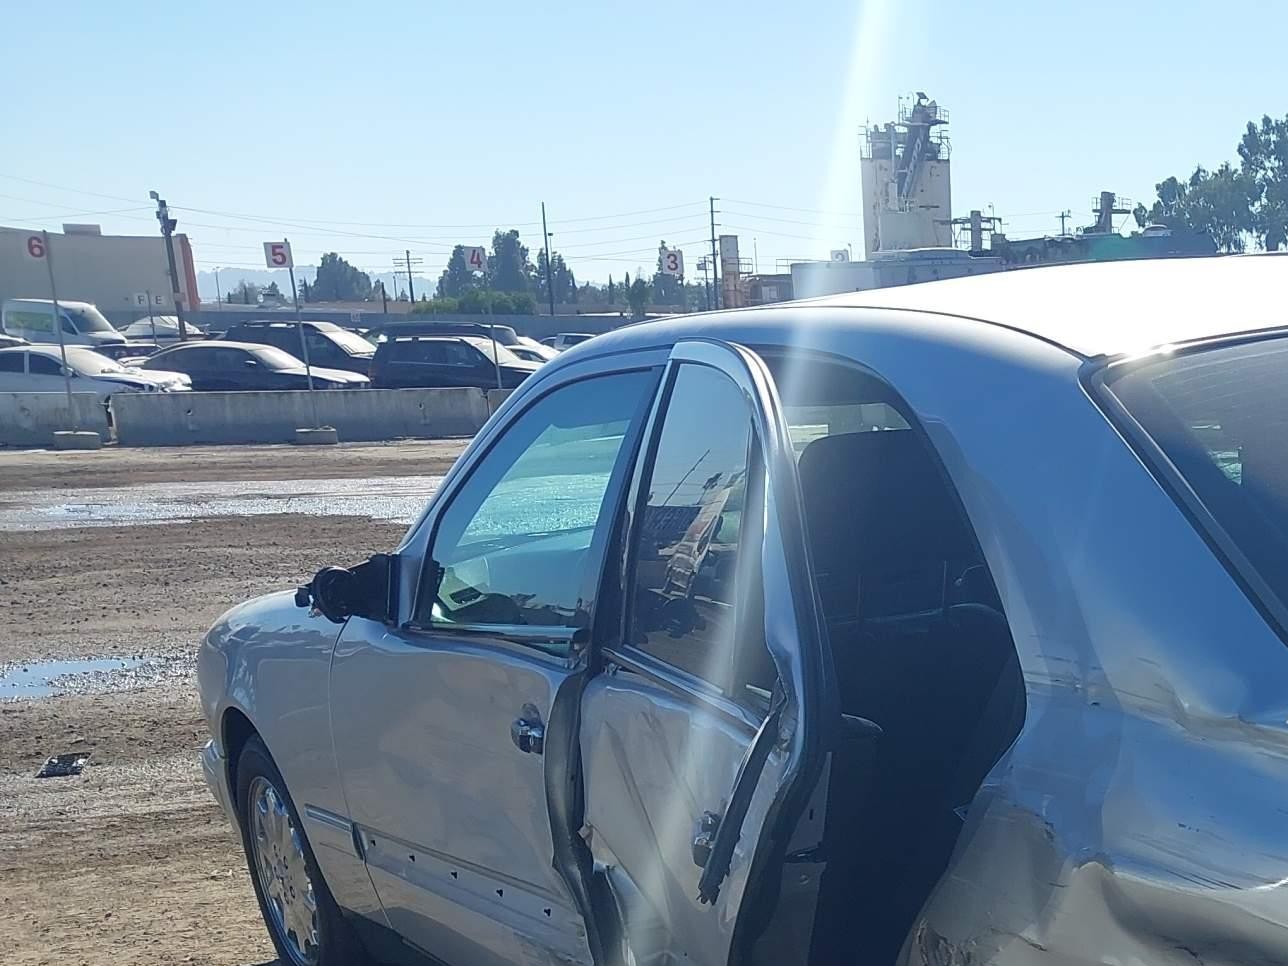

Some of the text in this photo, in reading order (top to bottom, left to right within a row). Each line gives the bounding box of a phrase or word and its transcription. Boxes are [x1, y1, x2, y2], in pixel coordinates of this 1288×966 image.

[27, 236, 45, 258] 6
[271, 245, 287, 265] 5
[470, 249, 483, 268] 4
[667, 253, 679, 271] 3
[137, 295, 145, 305] F
[155, 295, 163, 305] E
